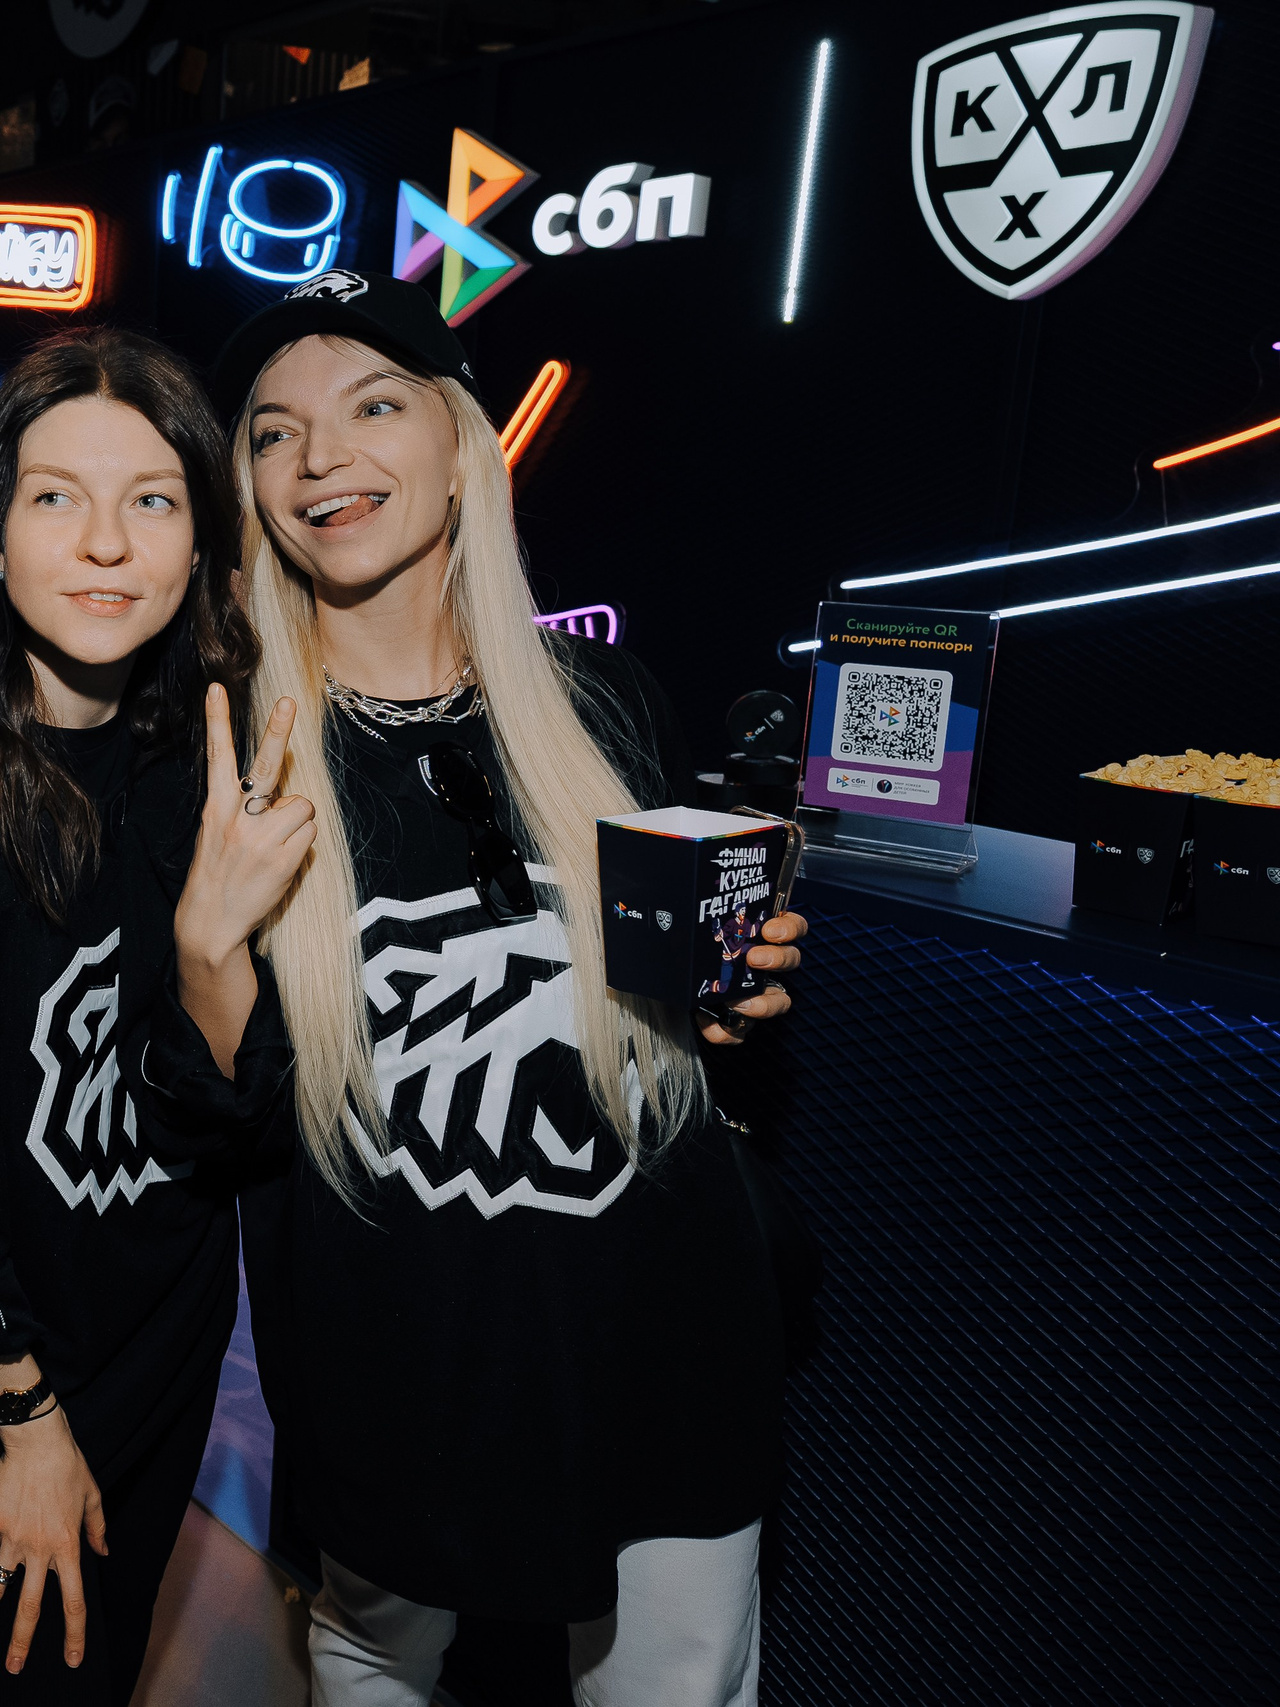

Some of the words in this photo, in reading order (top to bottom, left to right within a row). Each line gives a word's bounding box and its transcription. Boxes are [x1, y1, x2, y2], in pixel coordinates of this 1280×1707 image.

[532, 162, 710, 256] сбп
[846, 618, 930, 635] Сканируйте
[934, 624, 958, 636] QR
[829, 633, 839, 642] и
[841, 634, 907, 647] получите
[909, 639, 973, 653] попкорн
[710, 848, 767, 868] ФИНАЛ
[1105, 846, 1122, 855] сбп
[719, 866, 767, 892] КУБКА
[1230, 866, 1250, 876] сбп
[698, 882, 770, 923] ГАГАРИНА
[627, 909, 643, 920] сбп
